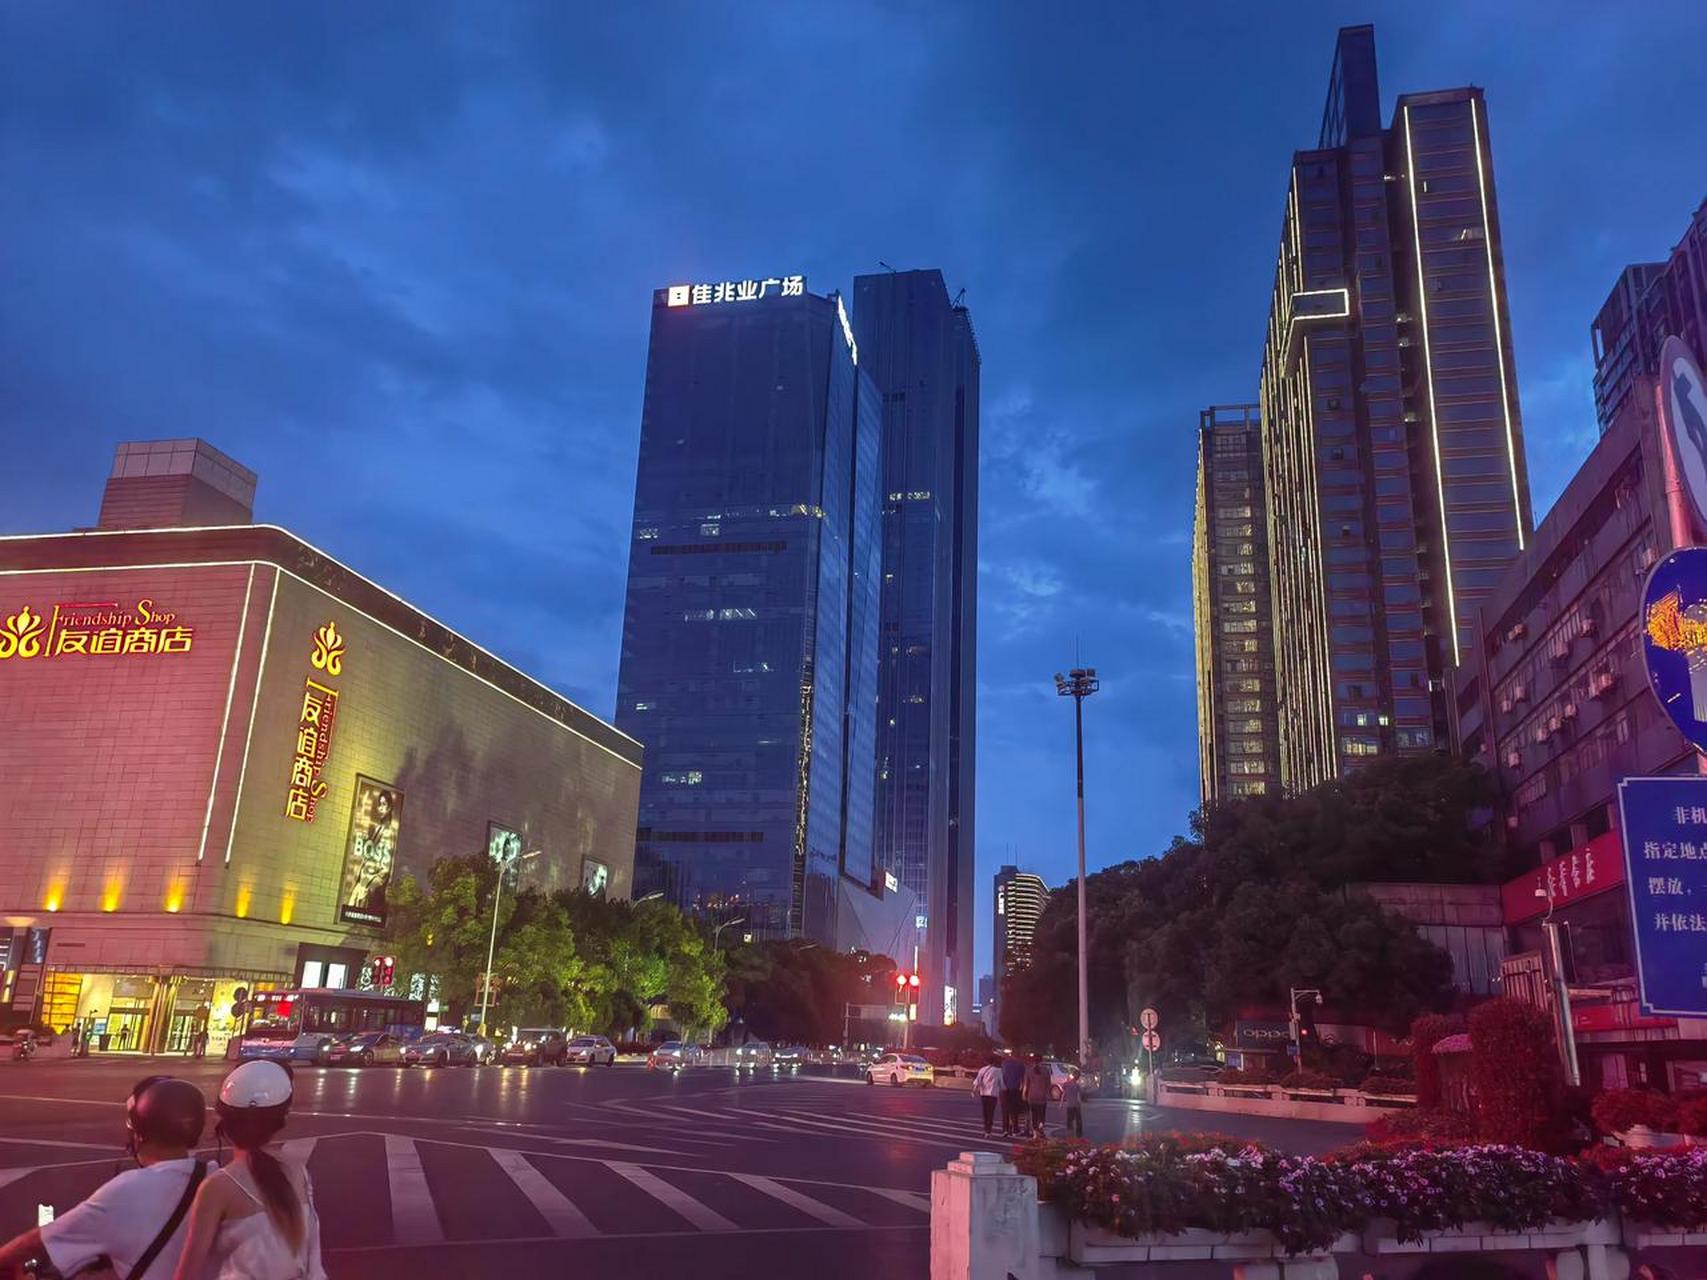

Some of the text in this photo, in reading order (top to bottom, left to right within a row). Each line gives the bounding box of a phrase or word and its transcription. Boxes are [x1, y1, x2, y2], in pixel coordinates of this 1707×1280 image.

[691, 275, 803, 305] 佳兆业广场
[135, 599, 175, 625] Shop
[55, 626, 194, 655] 友谊商店
[286, 692, 323, 820] 友谊商店
